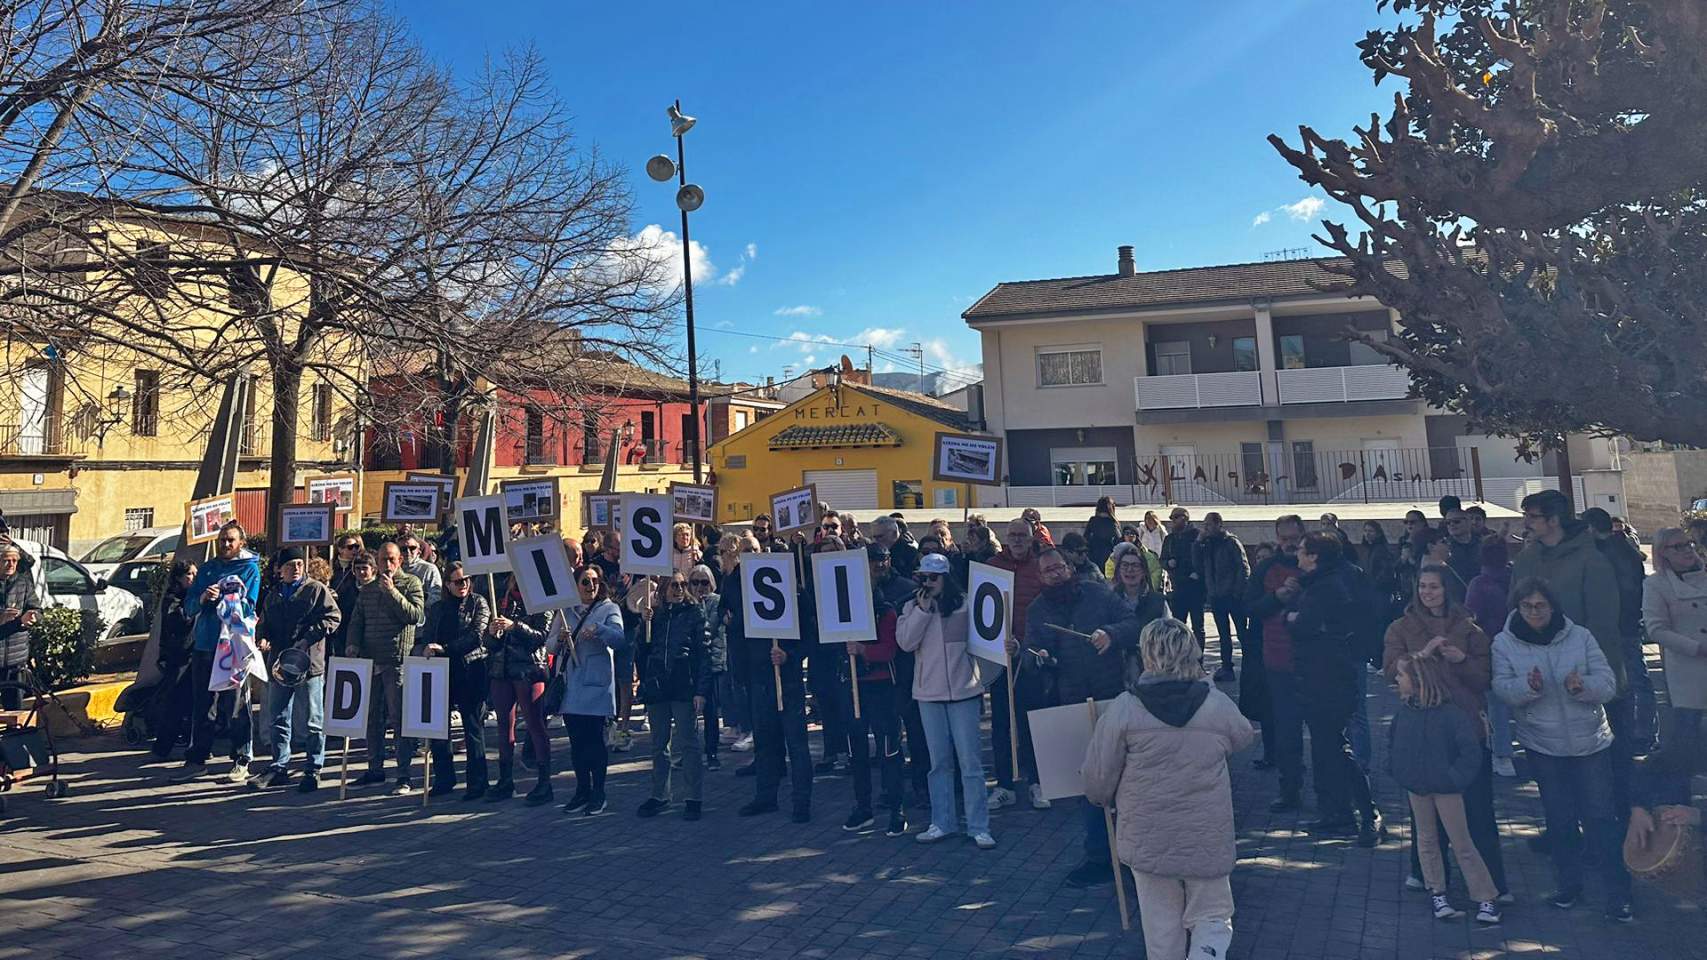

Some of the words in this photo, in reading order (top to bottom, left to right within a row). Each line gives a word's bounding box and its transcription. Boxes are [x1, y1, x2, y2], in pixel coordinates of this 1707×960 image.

[795, 404, 880, 418] MERCAT
[464, 508, 505, 558] M
[631, 507, 662, 558] S
[530, 548, 558, 598] I
[752, 566, 786, 622] S
[834, 566, 852, 624] I
[972, 582, 1004, 642] O
[332, 670, 362, 721] D
[422, 672, 432, 724] I
